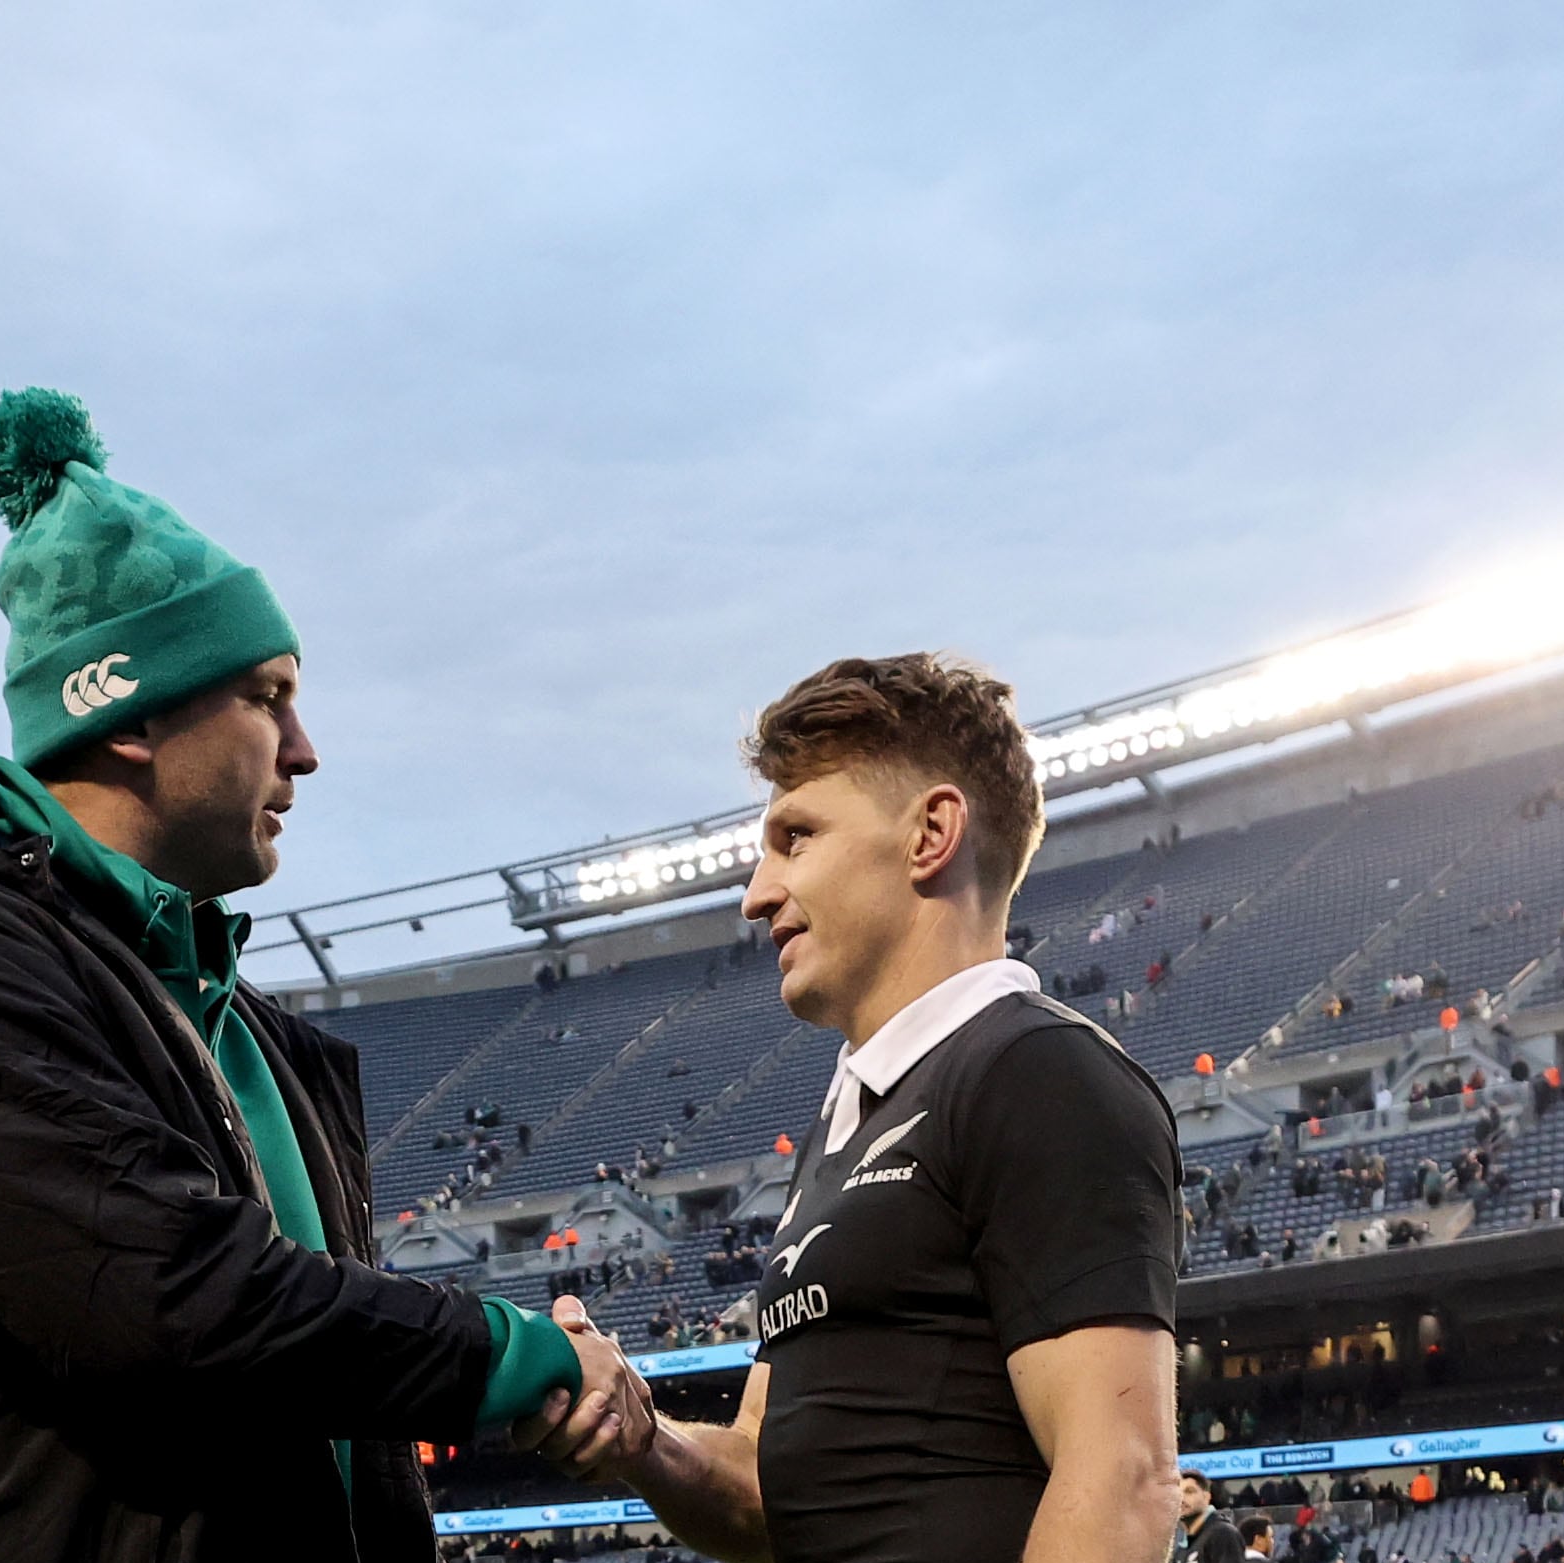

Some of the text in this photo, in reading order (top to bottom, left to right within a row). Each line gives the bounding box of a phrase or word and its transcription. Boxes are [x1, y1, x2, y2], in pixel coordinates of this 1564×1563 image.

[858, 1166, 914, 1186] BLACKS
[760, 1283, 829, 1345] ALTRAD
[1418, 1437, 1482, 1455] Gallagher
[1229, 1454, 1255, 1470] Cup
